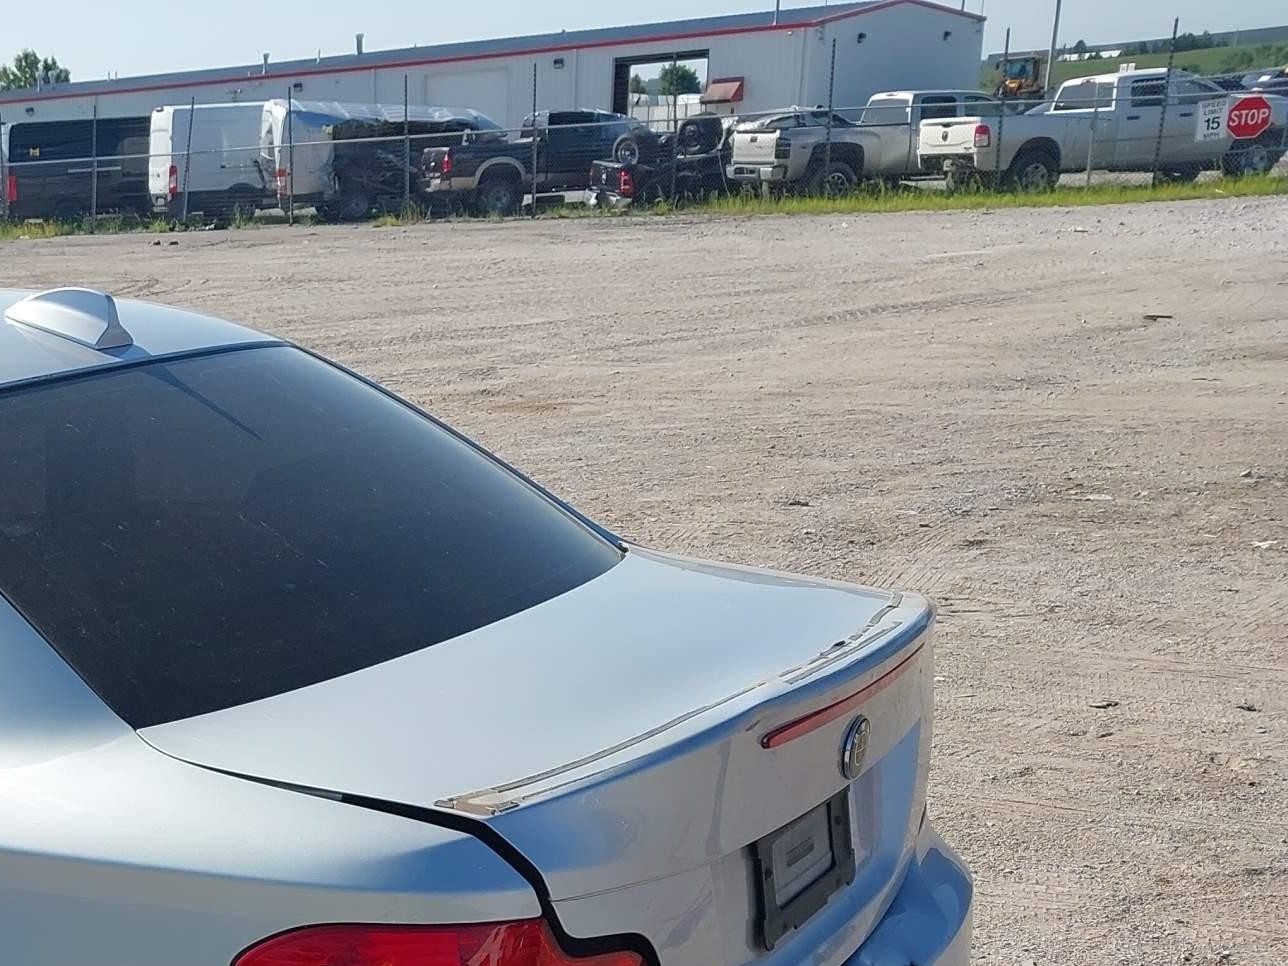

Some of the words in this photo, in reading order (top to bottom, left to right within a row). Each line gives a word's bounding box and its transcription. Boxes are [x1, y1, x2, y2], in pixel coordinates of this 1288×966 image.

[1203, 108, 1224, 116] LIMIT
[1229, 108, 1269, 127] STOP
[1204, 116, 1221, 131] 15
